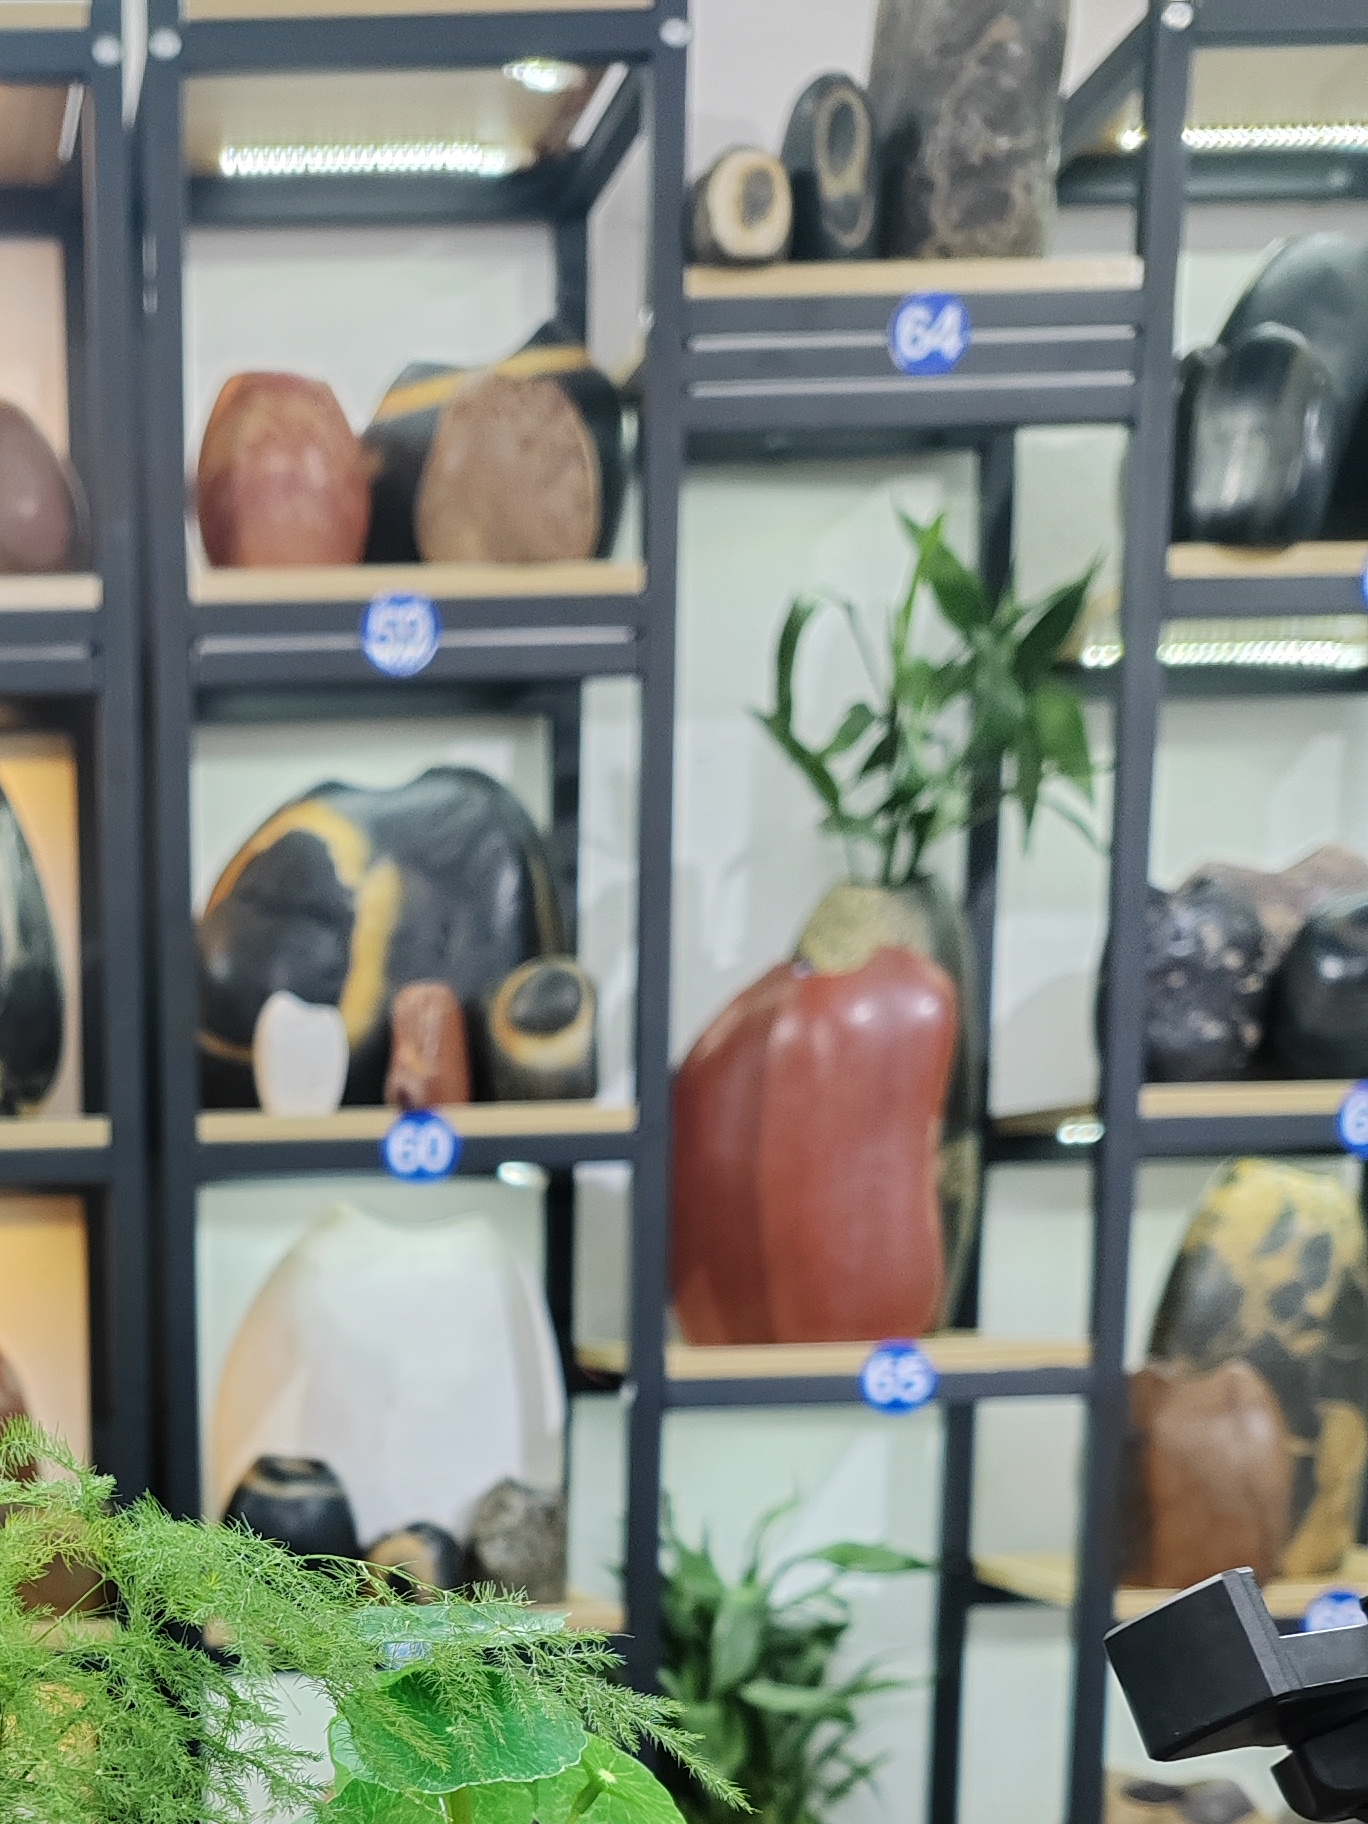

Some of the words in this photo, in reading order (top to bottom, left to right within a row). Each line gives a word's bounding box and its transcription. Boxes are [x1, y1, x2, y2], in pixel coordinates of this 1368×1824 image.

[896, 303, 963, 361] 64
[388, 1122, 453, 1172] 60
[865, 1355, 934, 1403] 65
